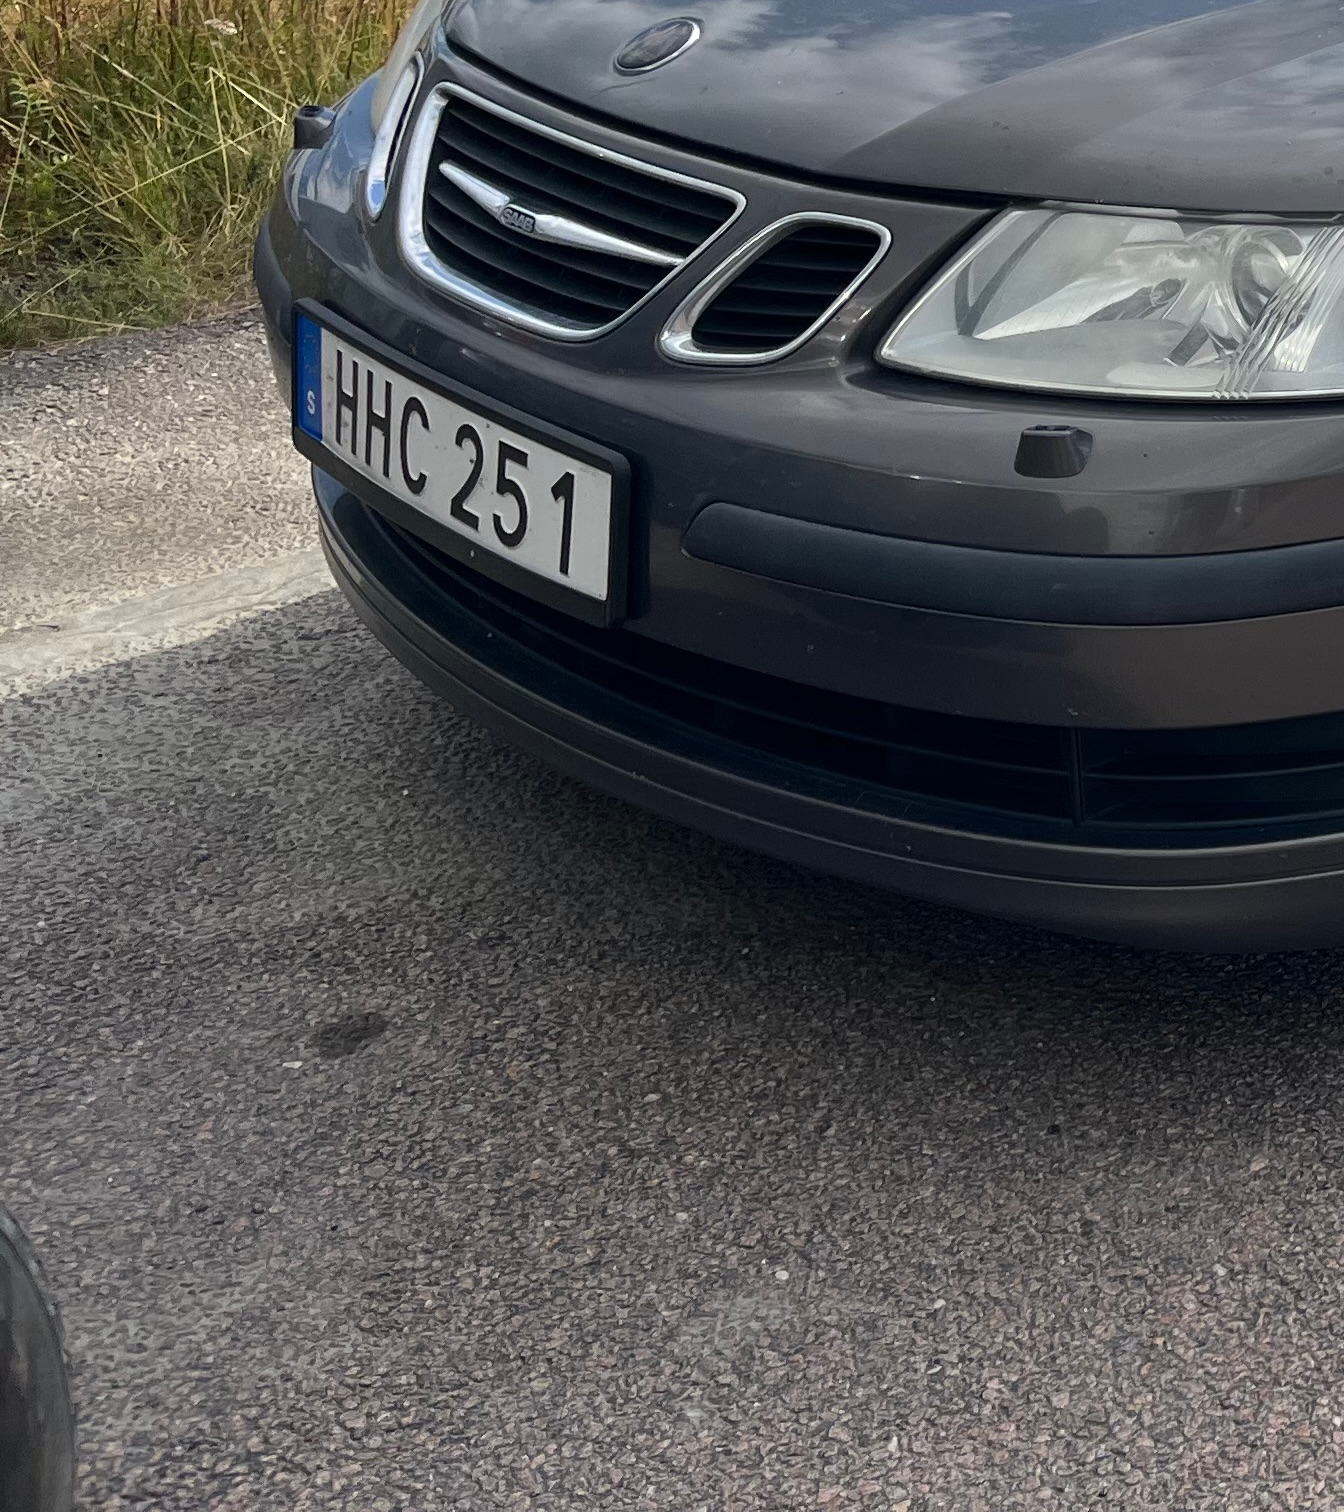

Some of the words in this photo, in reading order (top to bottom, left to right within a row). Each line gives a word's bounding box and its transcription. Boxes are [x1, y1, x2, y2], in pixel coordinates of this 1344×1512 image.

[503, 208, 535, 233] SAAB
[307, 390, 316, 415] S
[335, 349, 431, 496] HHC
[450, 422, 576, 578] 251
